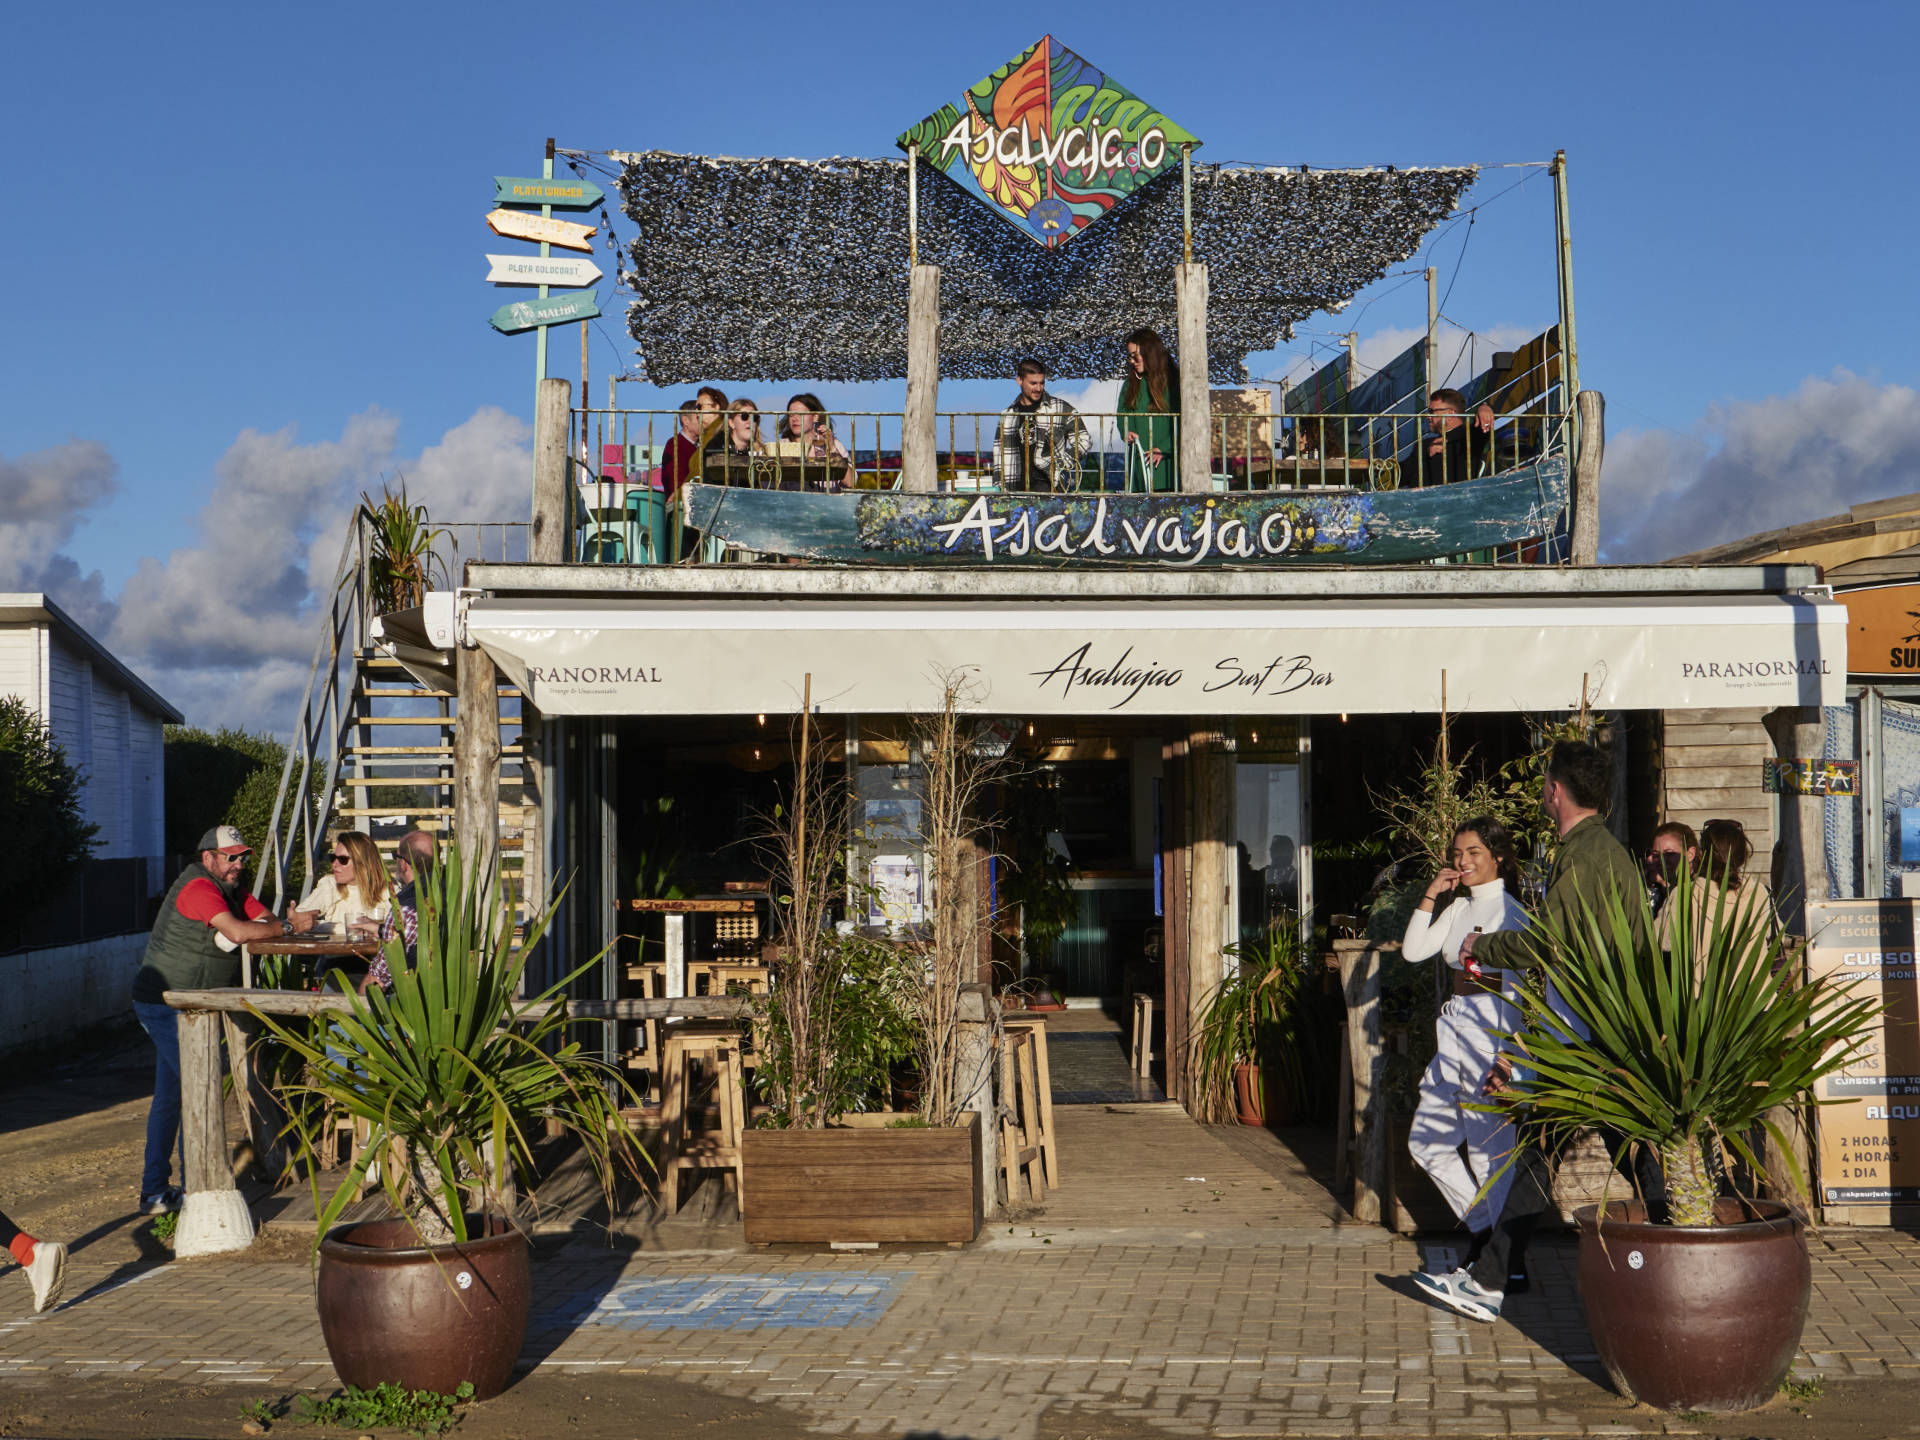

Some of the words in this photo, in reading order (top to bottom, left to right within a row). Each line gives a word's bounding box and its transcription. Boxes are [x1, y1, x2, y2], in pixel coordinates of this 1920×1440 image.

[513, 185, 543, 197] PLAYA
[508, 263, 533, 273] PLAYA
[535, 265, 579, 275] GOLDCOAST
[537, 303, 578, 319] MALIBU
[933, 497, 1291, 566] Asalvajao
[1890, 647, 1920, 669] SU
[1682, 660, 1832, 678] PARANORMAL
[1028, 641, 1184, 710] Asalvajao
[1203, 656, 1283, 696] Surf
[1268, 655, 1334, 696] Bar
[1825, 914, 1854, 925] SURF
[1857, 913, 1903, 924] SCHOOL
[1840, 927, 1889, 937] ESCUELA
[1835, 1077, 1877, 1086] CURSOS
[1841, 1137, 1848, 1147] 2
[1852, 1136, 1898, 1147] HORAS
[1842, 1153, 1849, 1163] 4
[1854, 1151, 1900, 1162] HORAS
[1842, 1169, 1849, 1178] 1
[1854, 1167, 1878, 1178] DIA
